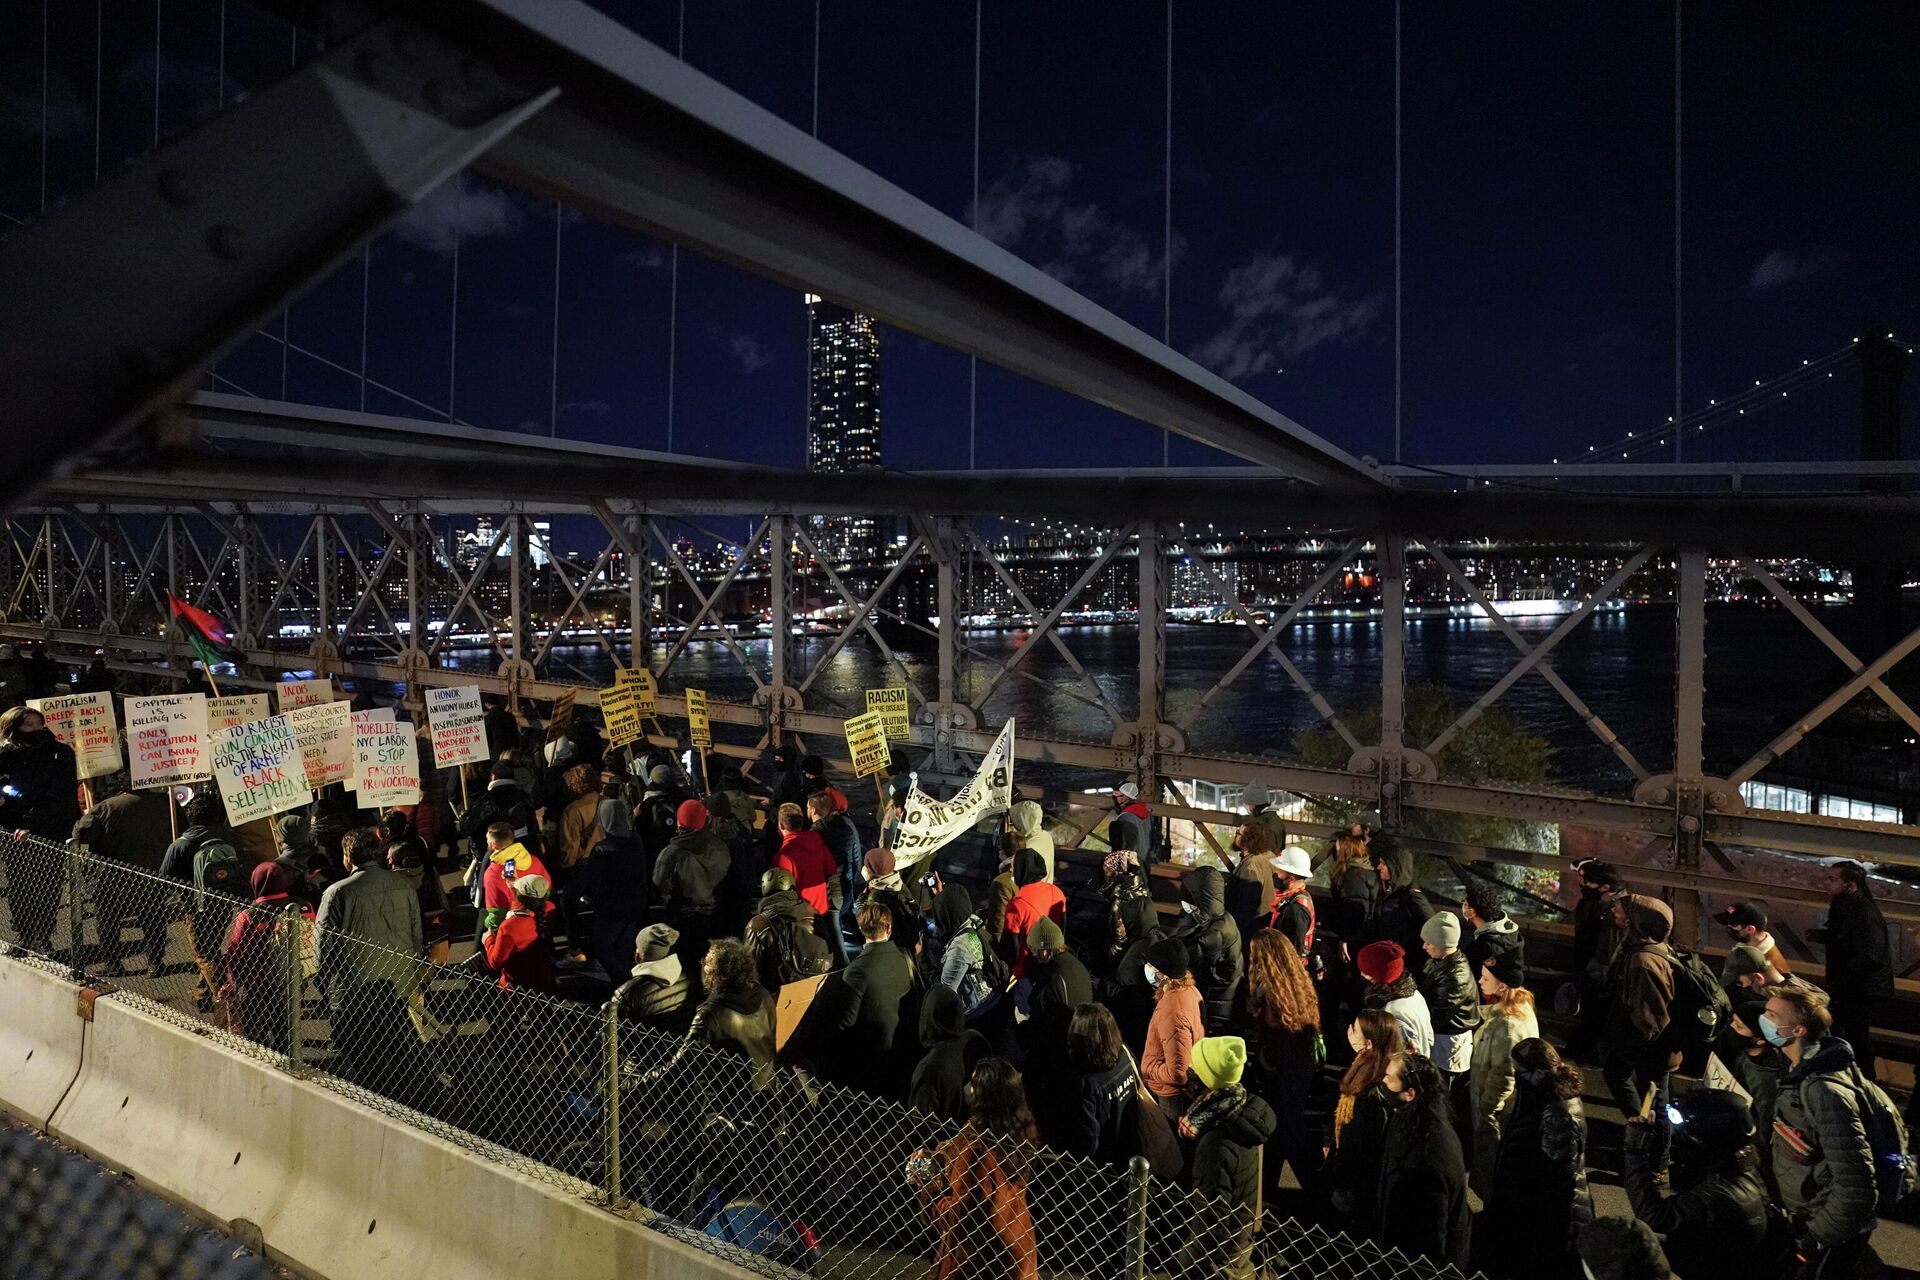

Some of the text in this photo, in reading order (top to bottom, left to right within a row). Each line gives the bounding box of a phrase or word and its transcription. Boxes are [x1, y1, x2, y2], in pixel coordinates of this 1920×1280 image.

[283, 684, 309, 698] JACOB
[434, 689, 461, 700] HONOR
[868, 689, 906, 704] RACISM
[43, 695, 97, 712] CAPITALISM
[251, 697, 258, 705] IS
[295, 695, 319, 706] BLAKE
[459, 700, 481, 711] HUBER
[80, 706, 106, 716] RACIST
[151, 707, 165, 715] IS
[245, 708, 255, 716] US
[321, 705, 347, 717] COURTS
[132, 712, 187, 727] KILLING US
[228, 725, 244, 738] TO
[247, 715, 287, 735] RACIST
[882, 716, 908, 726] OLUTION
[138, 728, 168, 740] ONLY
[356, 722, 401, 735] MOBILIZE
[437, 725, 480, 739] PROTESTERS
[610, 721, 640, 738] GUILTY!
[138, 734, 197, 752] REVOLUTION
[215, 738, 240, 757] GUN
[244, 727, 292, 749] CONTROL
[320, 729, 338, 743] STATE
[357, 735, 408, 748] NYC LABOR
[434, 734, 481, 751] MURDERED IN
[849, 739, 859, 747] The
[140, 747, 199, 762] CAN BRING
[215, 737, 295, 769] FOR THE RIGHT
[304, 746, 328, 759] NEED A
[378, 748, 405, 763] STOP
[856, 742, 882, 755] verdict:
[855, 747, 888, 767] GUILTY!
[233, 762, 247, 777] OF
[368, 765, 407, 778] FASCIST
[242, 766, 287, 789] BLACK
[363, 776, 419, 791] PROVOCATIONS
[227, 773, 310, 811] SELF-DEFENSE
